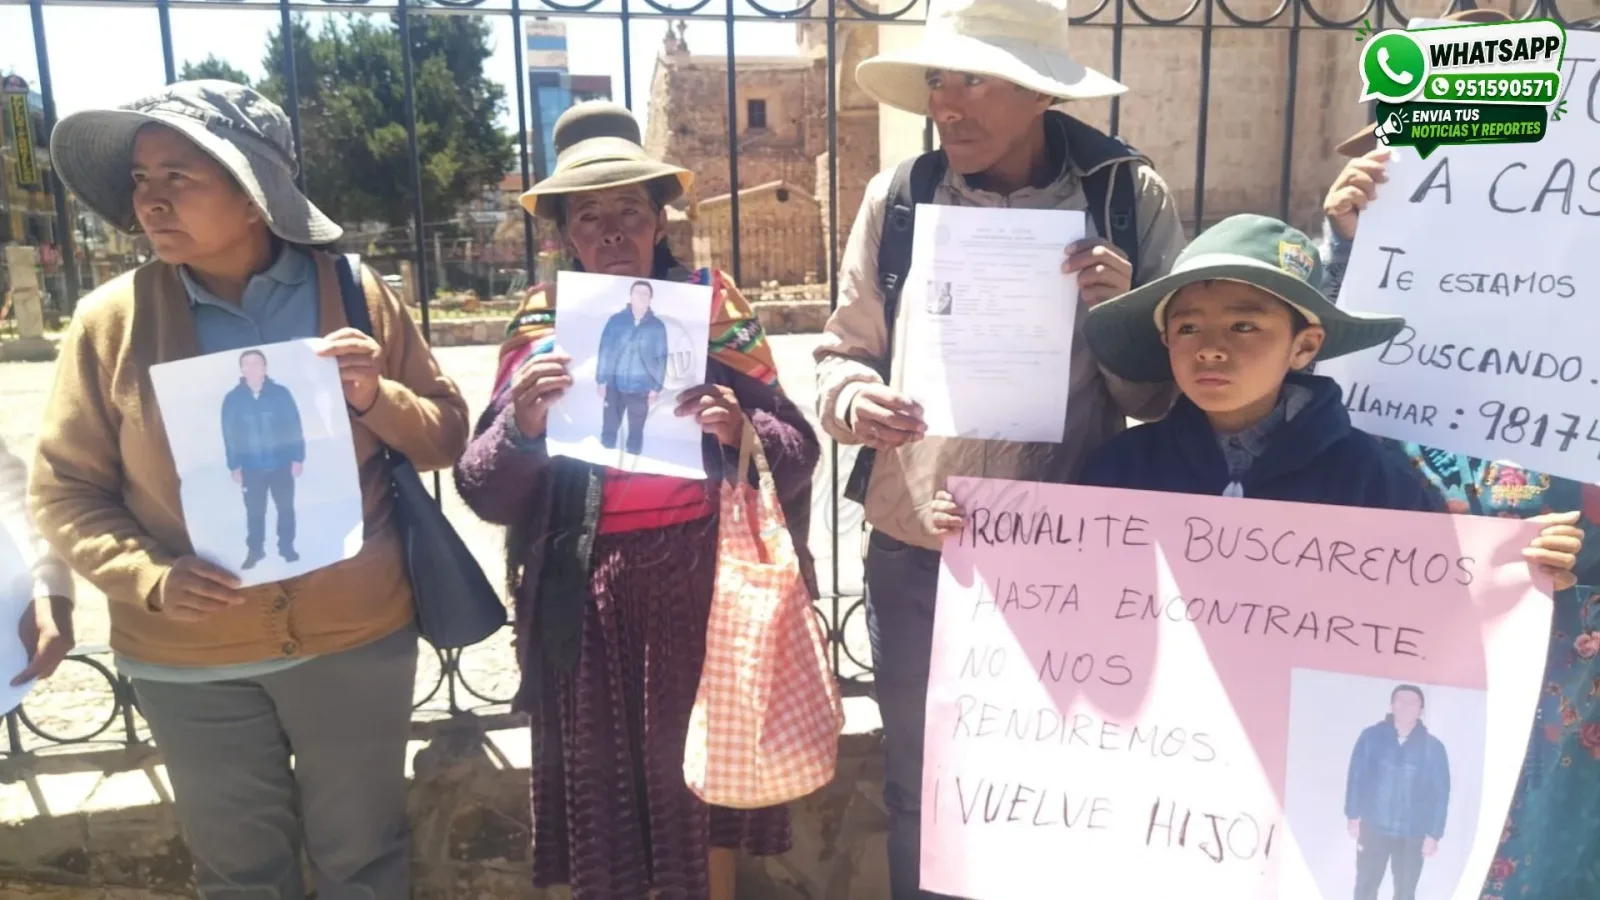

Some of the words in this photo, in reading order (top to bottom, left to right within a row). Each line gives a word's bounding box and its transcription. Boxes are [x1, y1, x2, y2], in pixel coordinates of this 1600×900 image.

[1409, 156, 1452, 205] A
[1439, 271, 1576, 299] ESTAMOS
[1094, 514, 1150, 548] TE
[1184, 516, 1476, 587] BUSCAREMOS
[972, 577, 1080, 622] HASTA
[1114, 587, 1427, 660] ENCONTRARTE.
[959, 645, 1007, 679] NO
[1038, 650, 1133, 686] NOS
[1145, 797, 1276, 876] HIJO!
